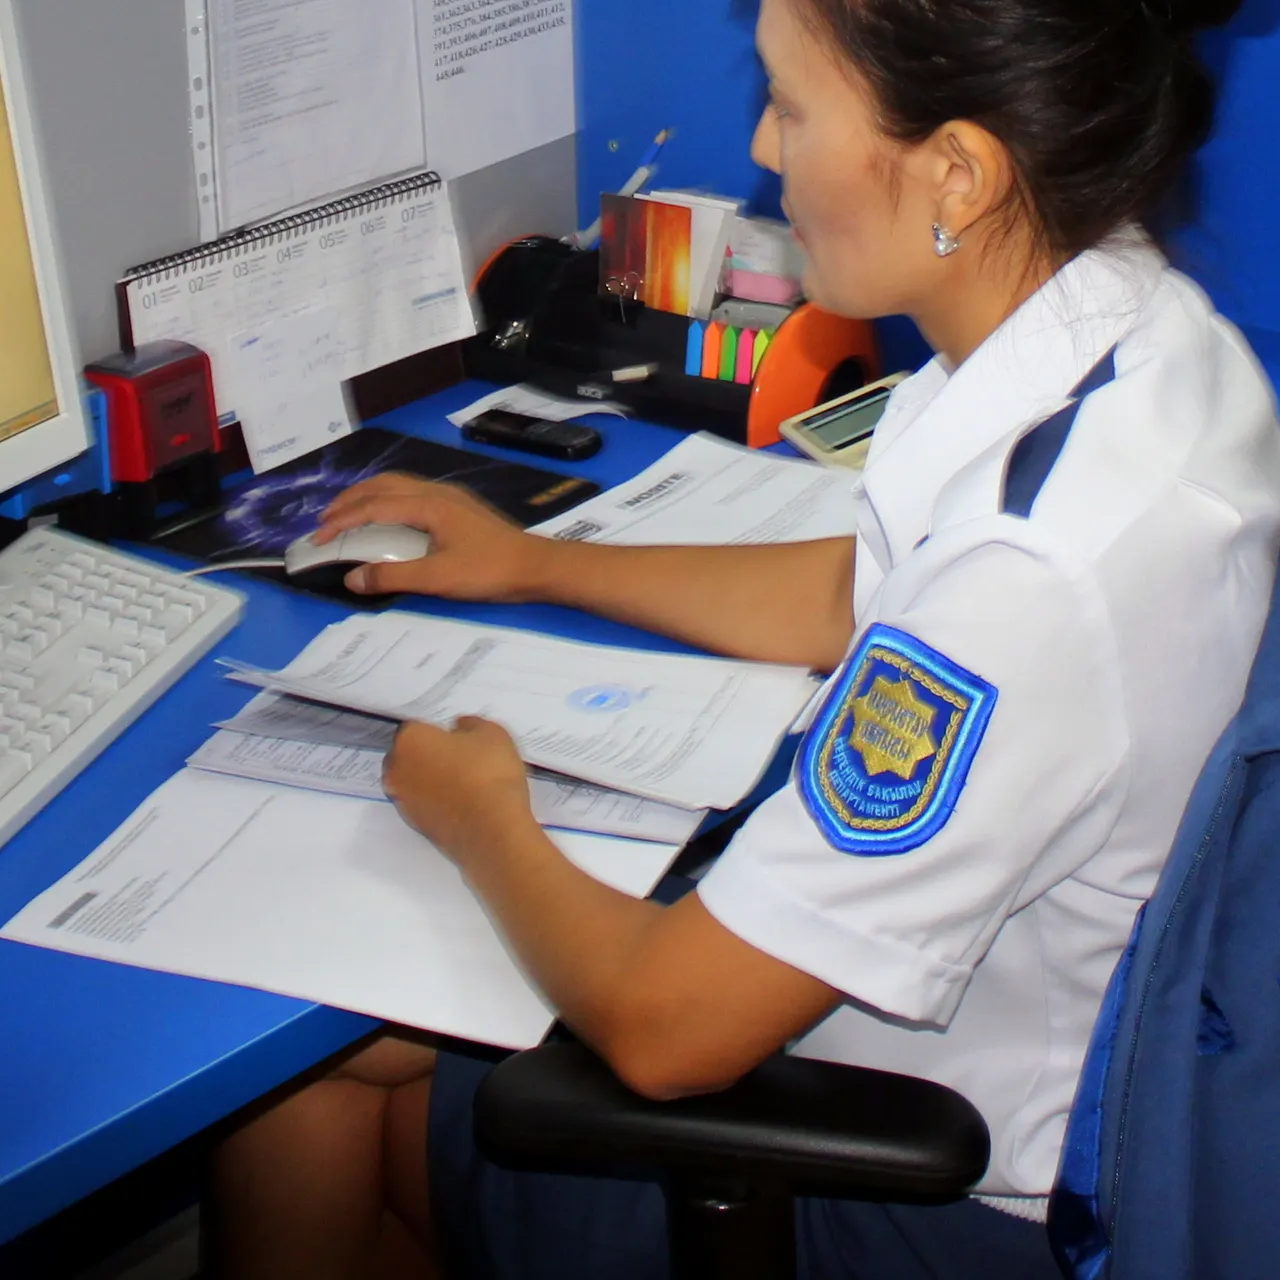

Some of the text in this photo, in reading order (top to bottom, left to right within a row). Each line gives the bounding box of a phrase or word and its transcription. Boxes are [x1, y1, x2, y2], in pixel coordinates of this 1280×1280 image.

[142, 291, 158, 310] 01
[188, 276, 204, 294] 02
[233, 261, 249, 279] 03
[276, 248, 292, 264] 04
[319, 232, 335, 250] 05
[360, 219, 375, 236] 06
[401, 206, 416, 224] 07
